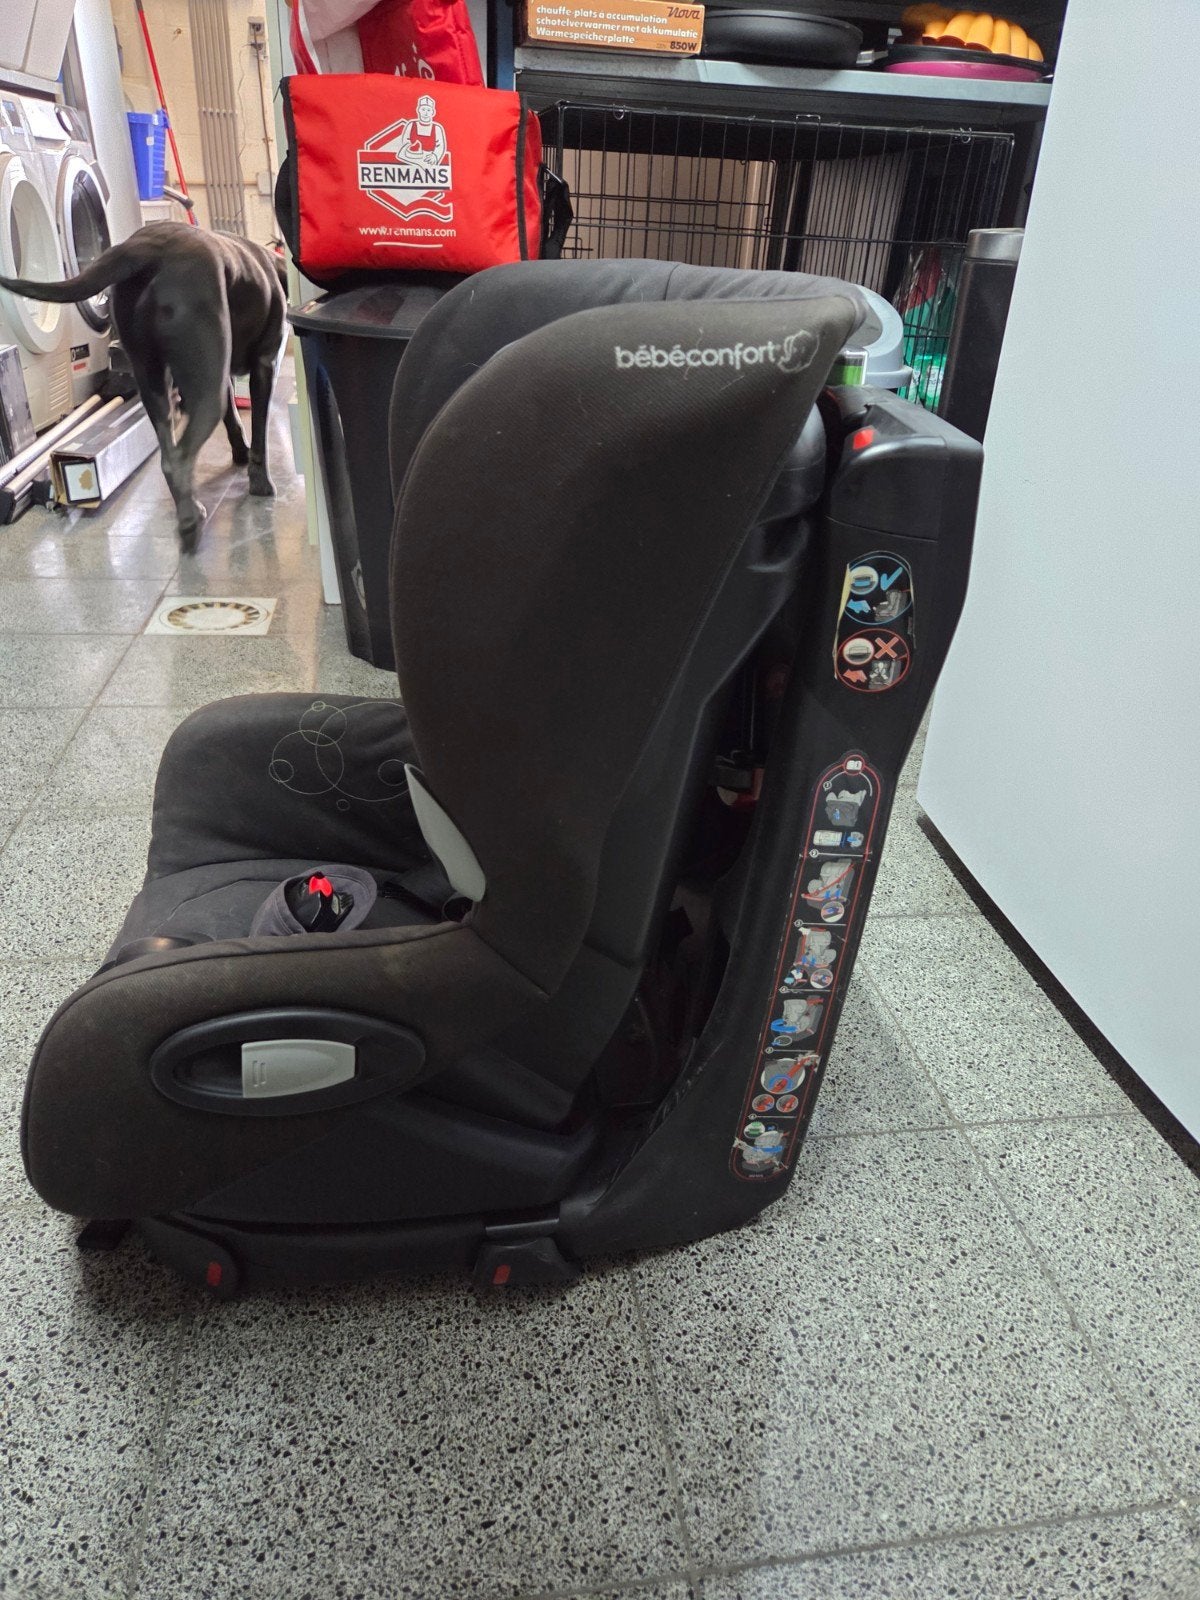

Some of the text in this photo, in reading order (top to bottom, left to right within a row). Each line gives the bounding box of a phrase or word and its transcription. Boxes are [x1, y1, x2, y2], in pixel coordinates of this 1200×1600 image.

[606, 12, 668, 25] accumulation
[667, 7, 701, 20] Nova
[536, 16, 699, 39] schotelverwarmer met akkumulatie
[670, 41, 698, 51] 850W
[361, 166, 449, 184] RENMANS
[359, 226, 457, 238] www.renmans.com
[614, 340, 776, 371] bébéconfort
